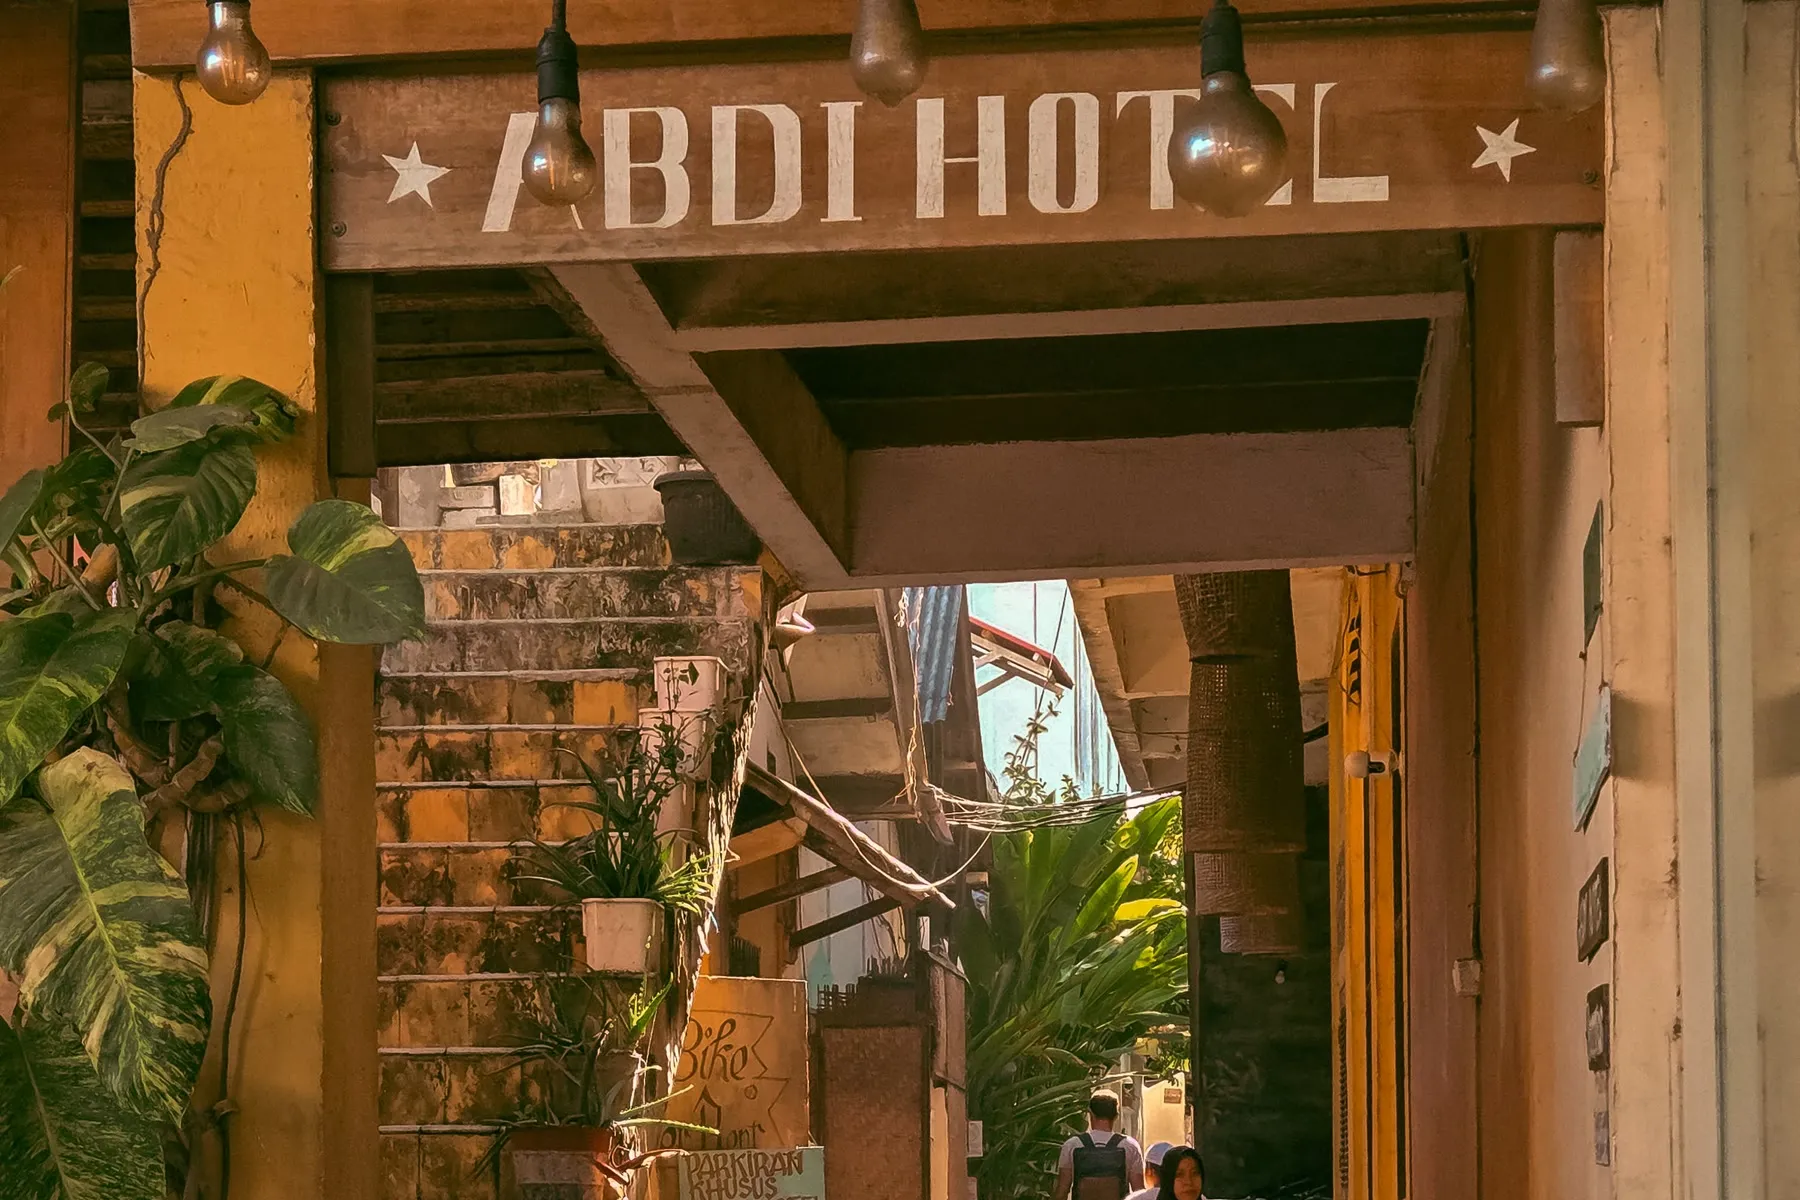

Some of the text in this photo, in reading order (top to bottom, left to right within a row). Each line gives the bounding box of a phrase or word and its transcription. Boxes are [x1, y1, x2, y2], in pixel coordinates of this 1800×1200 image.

[916, 82, 1390, 219] HOTL
[675, 1018, 748, 1082] Bike
[685, 1151, 804, 1180] PARKIRAN
